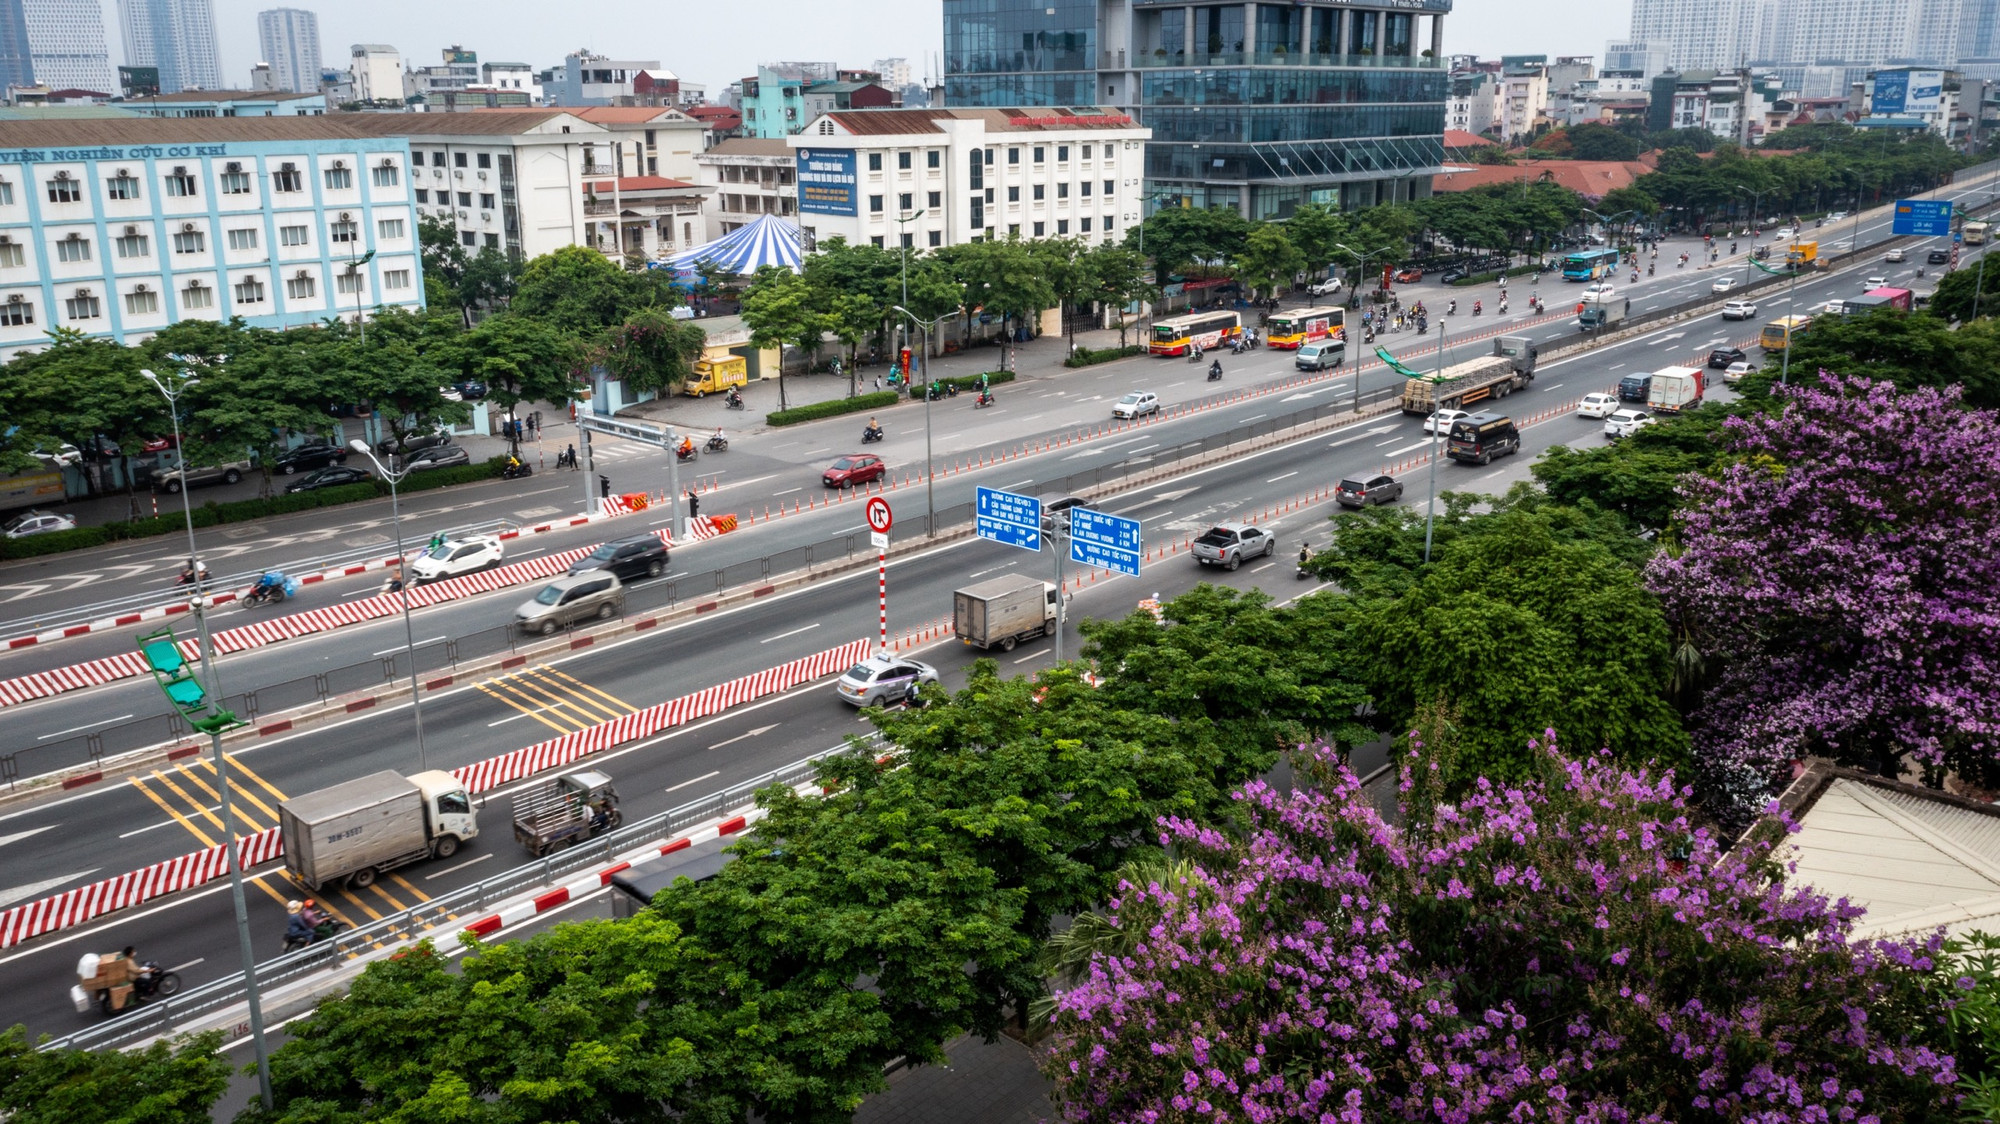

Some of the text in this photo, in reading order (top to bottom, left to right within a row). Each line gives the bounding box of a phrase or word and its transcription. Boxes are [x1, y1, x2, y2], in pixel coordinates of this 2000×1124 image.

[1, 144, 227, 164] VIỆN NGHIÊN CỨU CƠ KHÍ
[991, 492, 1004, 501] ĐƯỜNG
[1013, 506, 1022, 514] LONG
[1093, 514, 1104, 524] QUỐC
[1105, 518, 1113, 526] VIỆT
[1086, 531, 1099, 540] DƯƠNG
[1101, 535, 1114, 544] VƯƠNG
[1087, 545, 1100, 554] ĐƯỜNG
[1111, 562, 1121, 570] LONG
